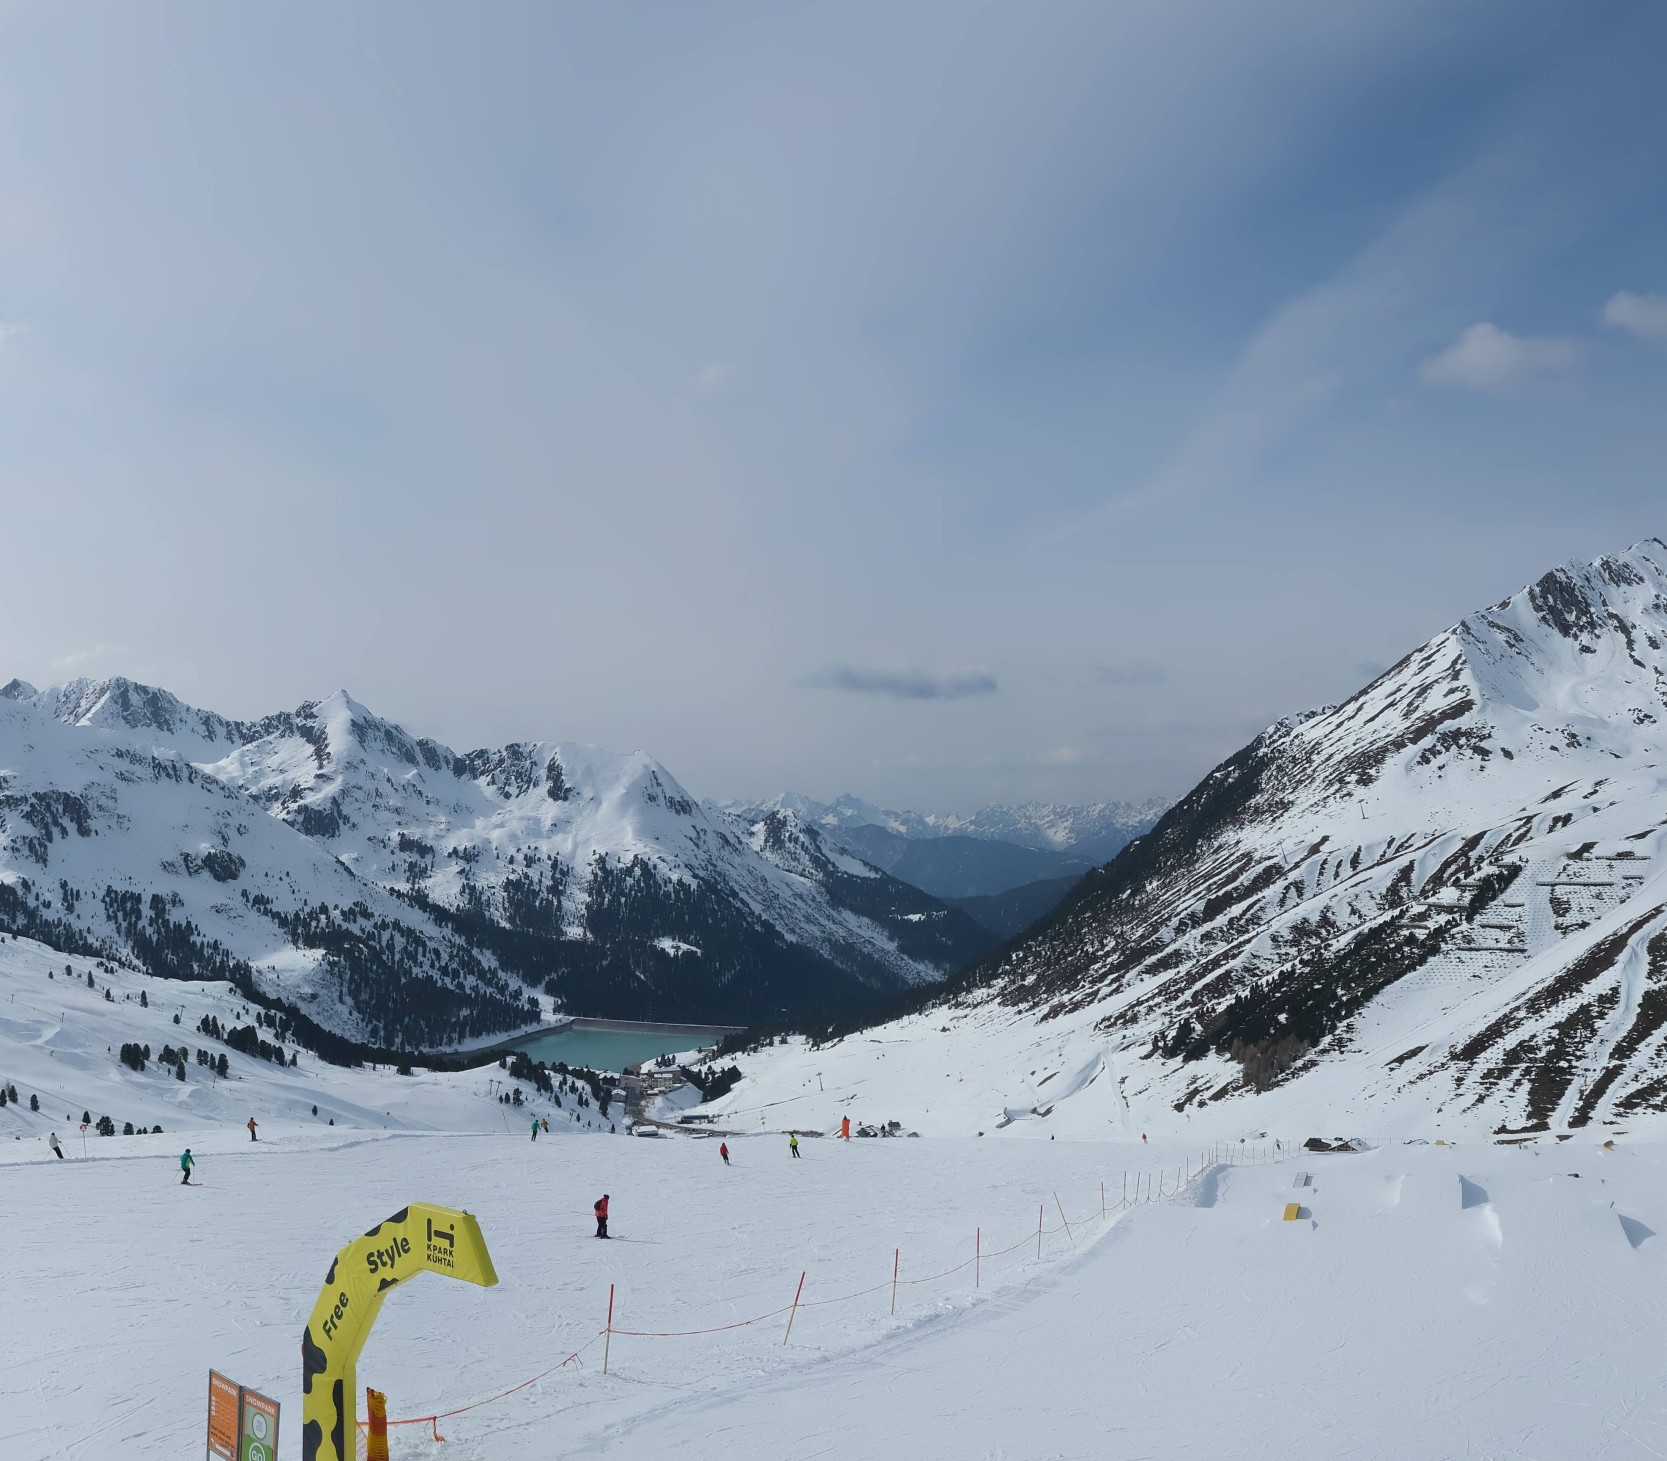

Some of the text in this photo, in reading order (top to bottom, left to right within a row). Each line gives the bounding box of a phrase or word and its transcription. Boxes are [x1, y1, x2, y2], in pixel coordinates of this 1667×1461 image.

[426, 1243, 454, 1258] KPARK
[426, 1252, 454, 1268] KÜHTAI
[322, 1237, 411, 1342] Free Style
[212, 1378, 237, 1396] SNOWPARK
[246, 1395, 275, 1414] SNOWPARK
[251, 1450, 262, 1461] GO
